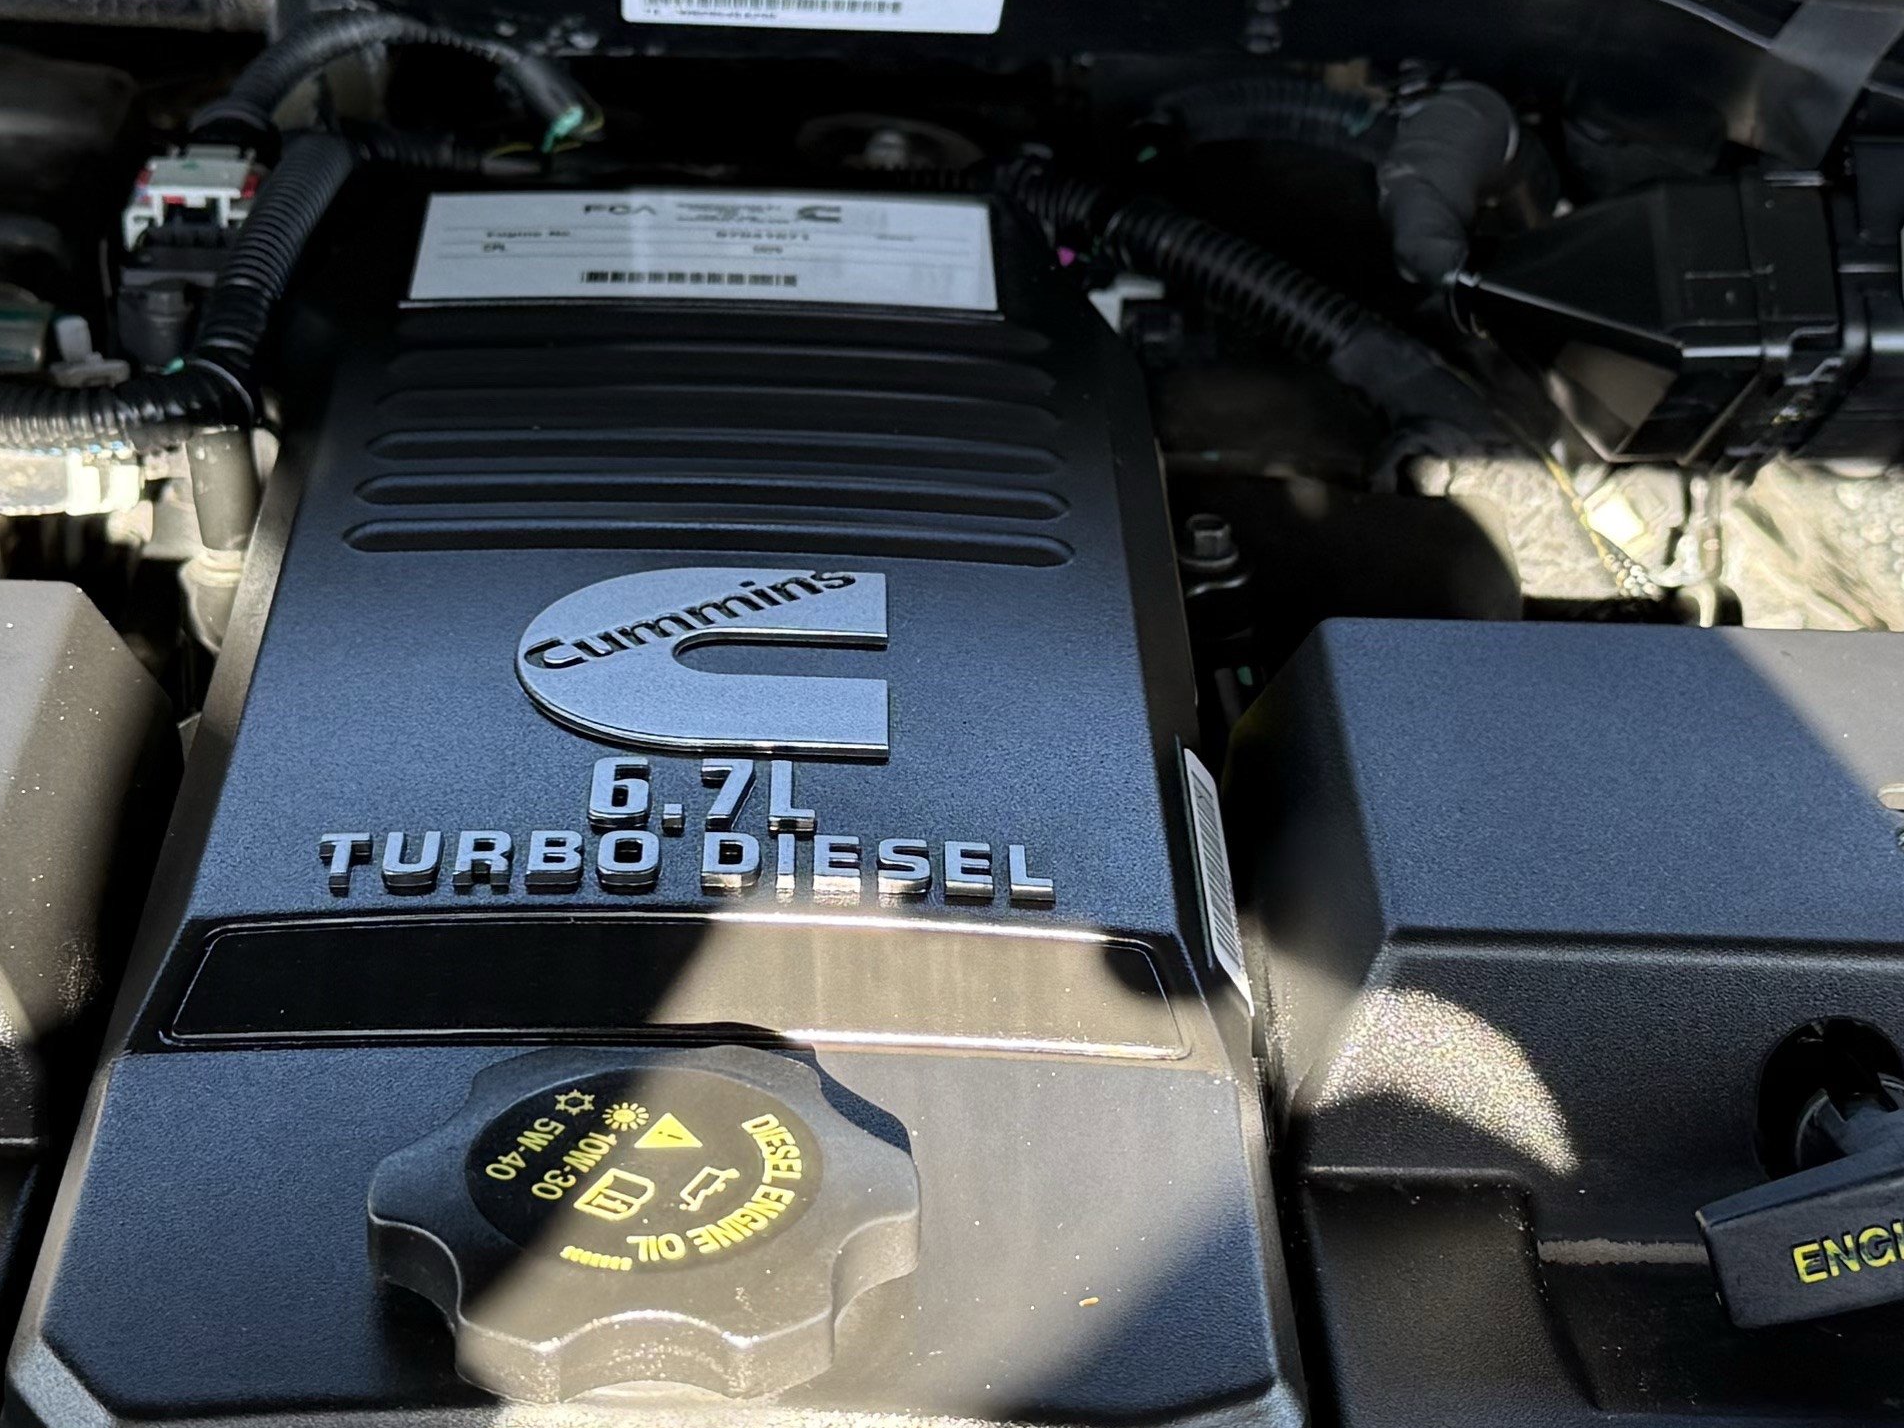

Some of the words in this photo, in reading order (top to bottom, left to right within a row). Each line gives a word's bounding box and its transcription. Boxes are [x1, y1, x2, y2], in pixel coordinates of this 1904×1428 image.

[523, 569, 858, 671] Cummins
[585, 755, 818, 837] 6.7L
[318, 828, 662, 896] TURBO
[700, 831, 1057, 908] DIESEL
[485, 1116, 565, 1181] 5W-40
[531, 1131, 618, 1201] 10W-30
[741, 1113, 803, 1184] DIESEL
[625, 1232, 687, 1262] OIL
[686, 1184, 796, 1255] ENGINE
